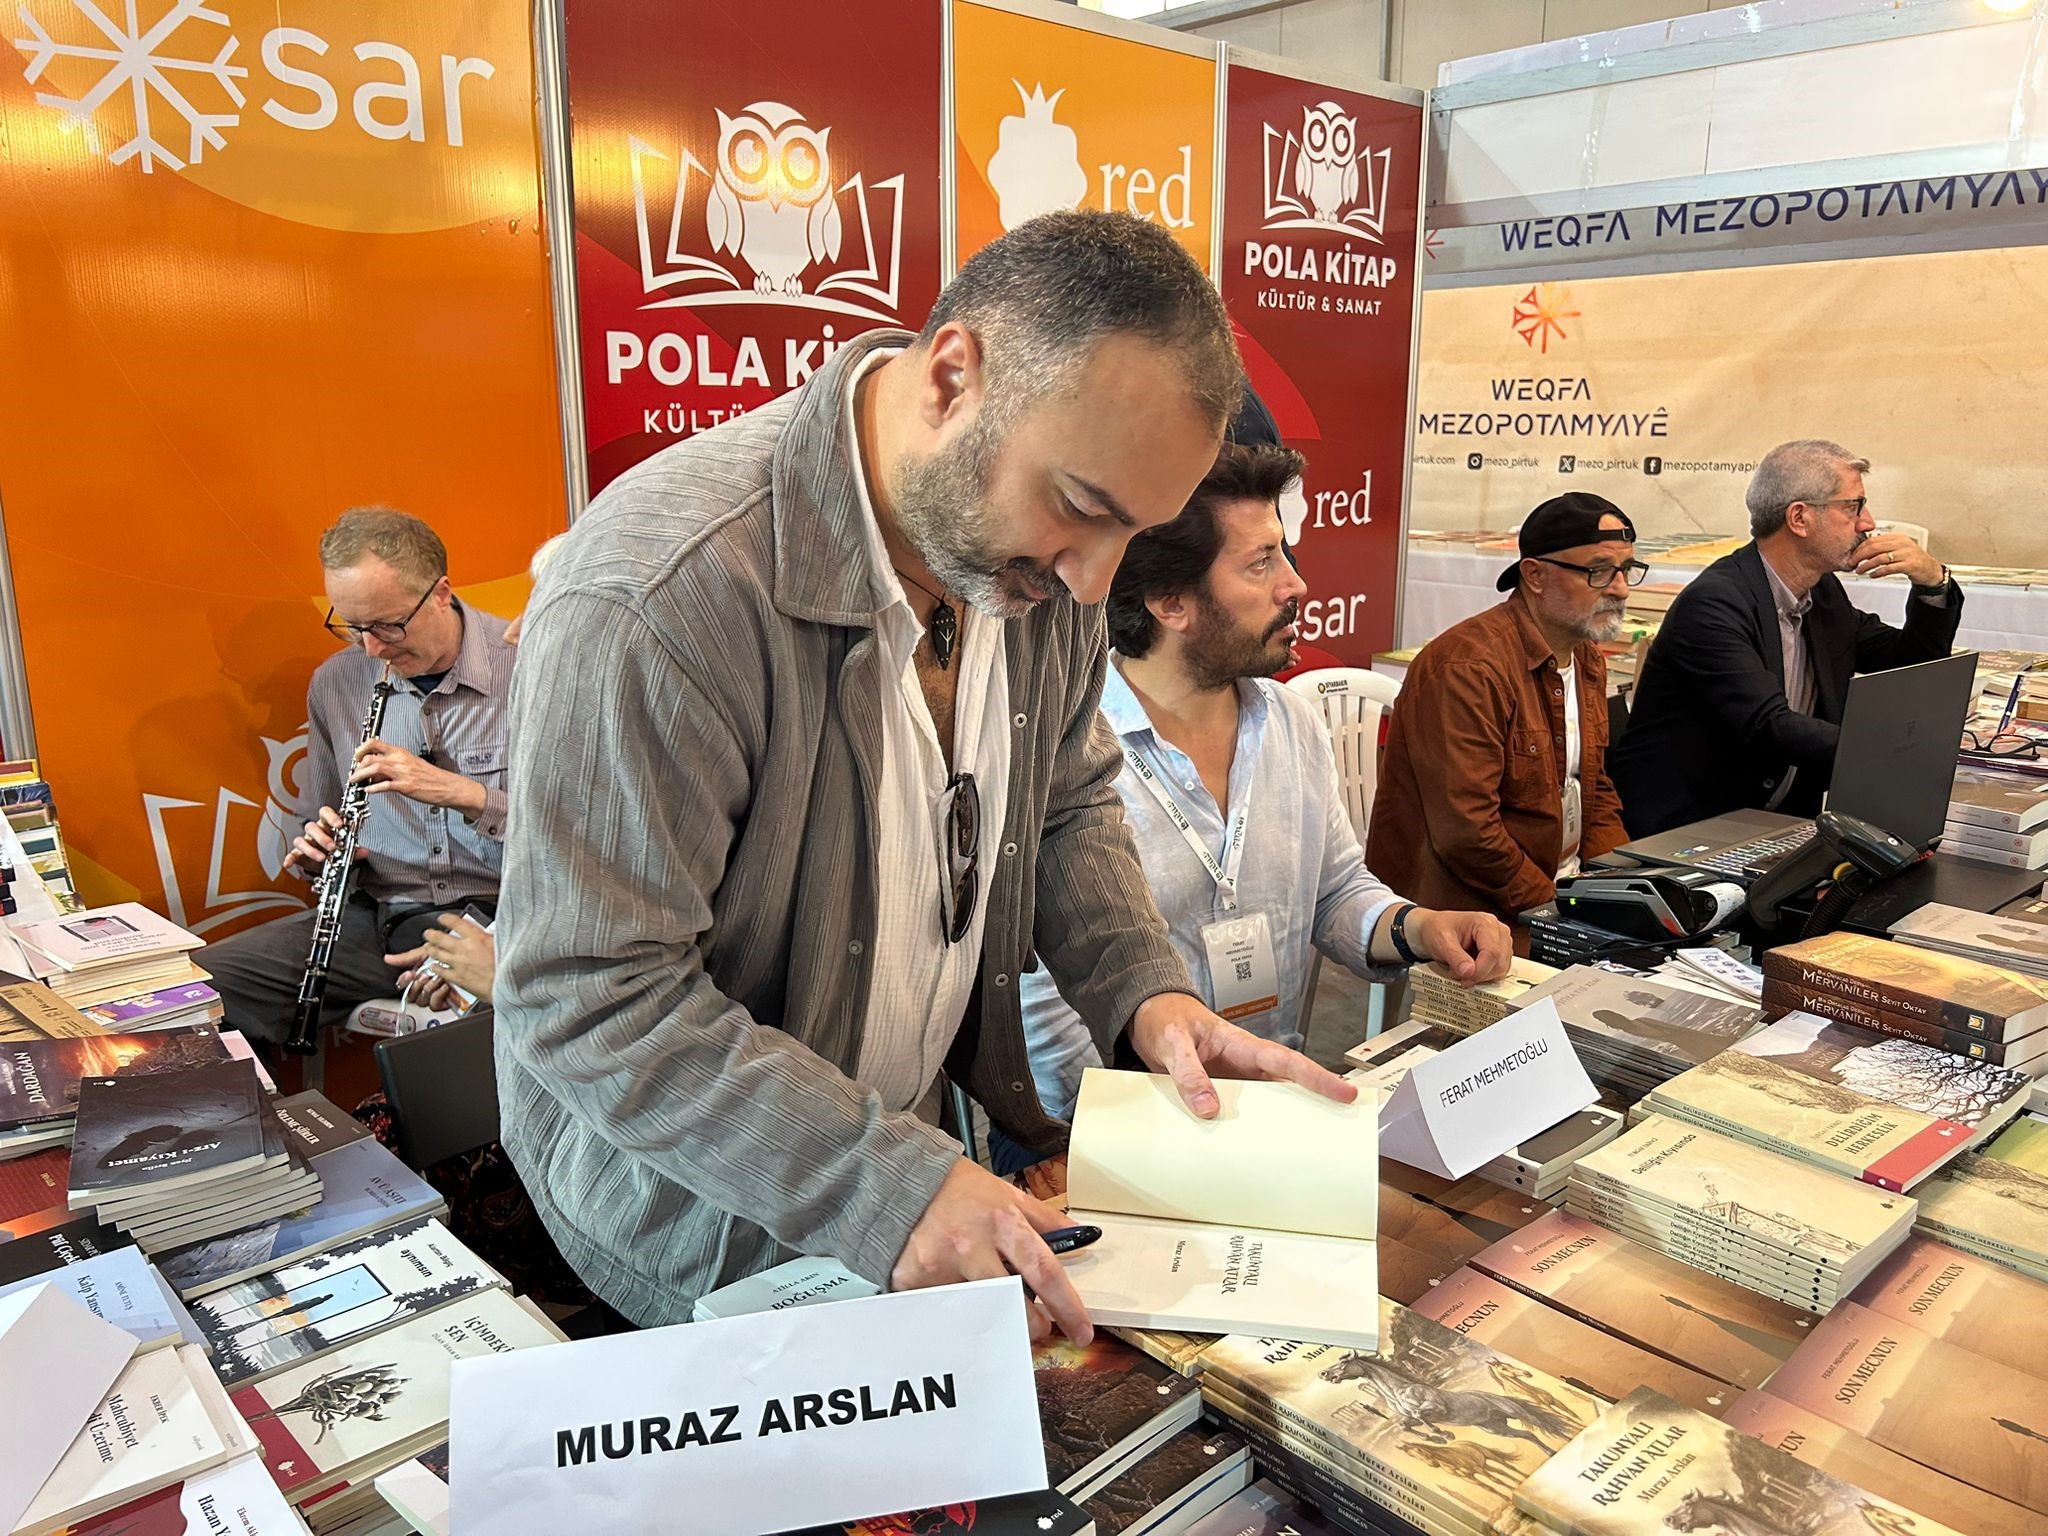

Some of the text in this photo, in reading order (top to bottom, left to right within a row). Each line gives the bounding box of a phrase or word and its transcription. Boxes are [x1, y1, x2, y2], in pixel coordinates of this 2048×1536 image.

[260, 27, 496, 147] sar
[1099, 145, 1196, 230] red
[1500, 211, 1631, 252] WEQFA
[1244, 241, 1397, 289] POLA KİTAP
[1257, 287, 1382, 316] KÜLTÜR & SANAT
[605, 331, 771, 388] POLA
[1491, 377, 1592, 402] WEQFA
[1418, 406, 1669, 437] MEZOPOTAMYAYÊ
[1577, 456, 1639, 472] mezo_pirtuk
[1312, 469, 1373, 528] red
[1302, 593, 1367, 641] sar
[1439, 1037, 1549, 1108] FERAT MEHMETOĞLU
[107, 1150, 178, 1168] Kıyamet
[1845, 1122, 1898, 1155] HERKESLİK
[400, 1248, 433, 1278] aynımsın
[1531, 1236, 1597, 1274] SON MECNUN
[77, 1275, 90, 1295] Kalp
[771, 1274, 850, 1312] BOĞUŞMA
[1908, 1263, 1966, 1316] SON MECNUN
[444, 1325, 469, 1344] SEN
[1454, 1300, 1500, 1335] ECNUN
[1834, 1336, 1898, 1405] SON MECNUN
[89, 1420, 115, 1464] Üzerime
[107, 1393, 139, 1450] Mahcubiyet
[556, 1373, 958, 1468] MURAZ ARSLAN
[1356, 1450, 1420, 1493] Muraz Arslan
[1577, 1421, 1655, 1482] TAKUNYALI
[1591, 1425, 1688, 1506] RAHVAN ATLAR
[1362, 1469, 1427, 1513] Muraz Arslan
[1636, 1452, 1697, 1503] Muraz Arslan
[197, 1493, 222, 1529] Hazan
[1362, 1487, 1428, 1531] Muraz Arslan
